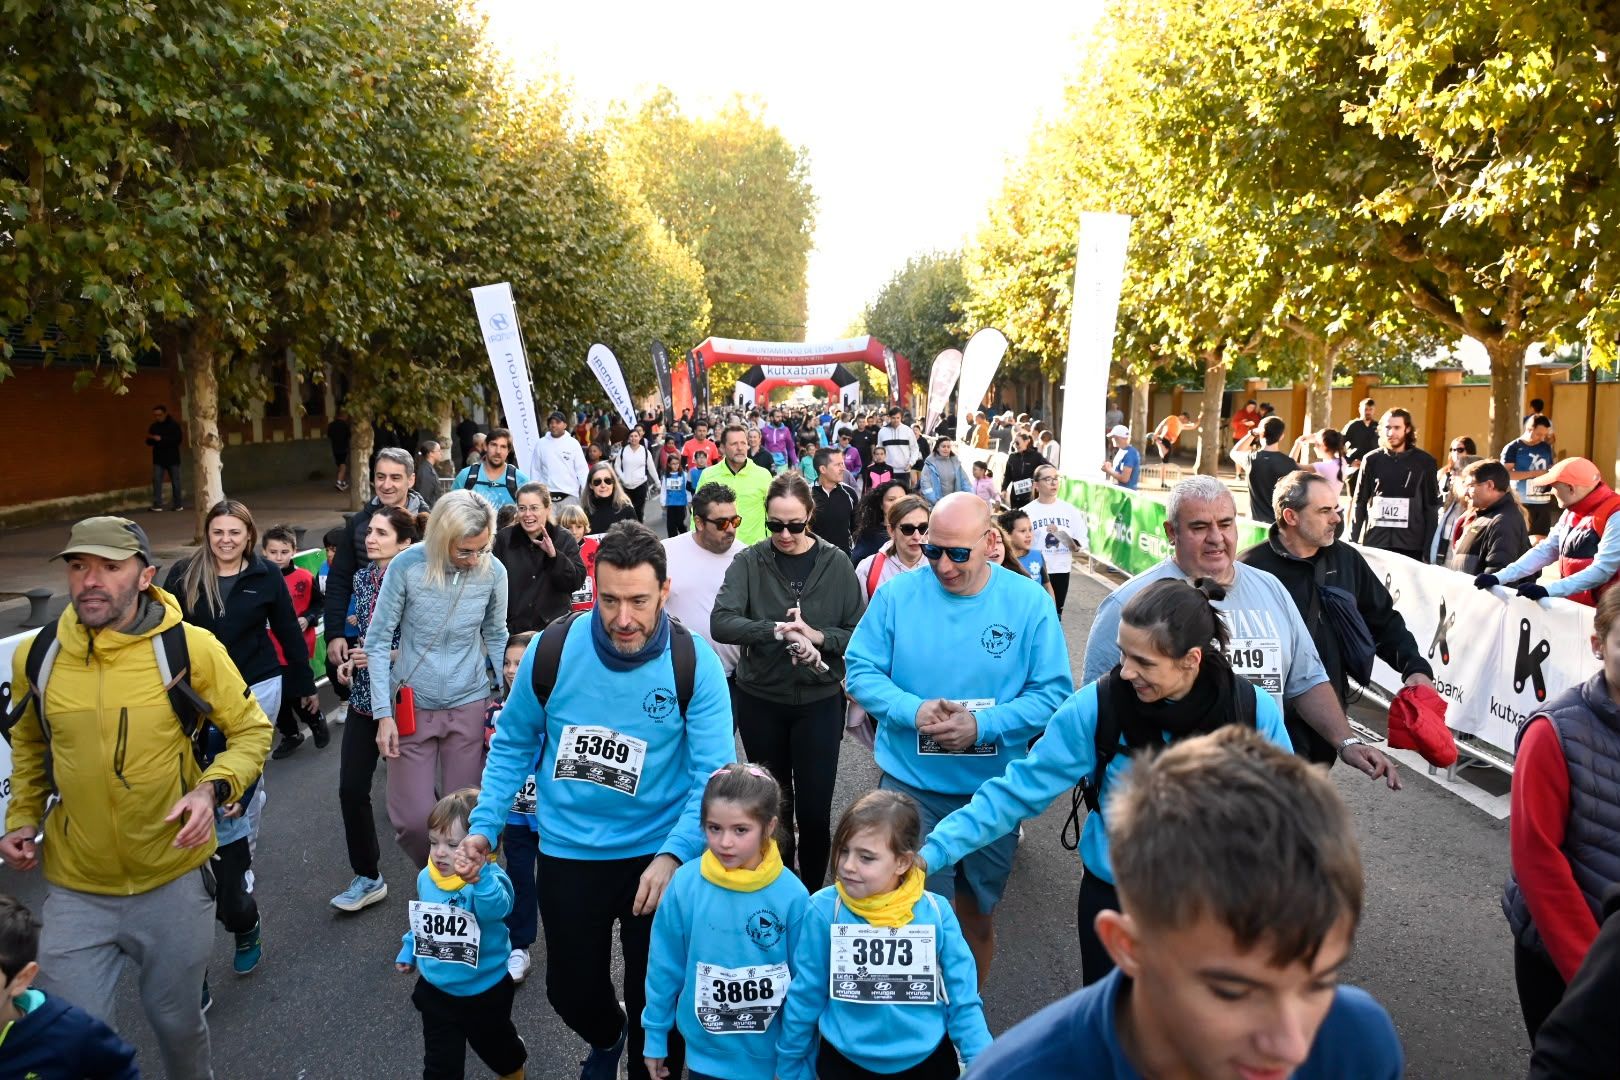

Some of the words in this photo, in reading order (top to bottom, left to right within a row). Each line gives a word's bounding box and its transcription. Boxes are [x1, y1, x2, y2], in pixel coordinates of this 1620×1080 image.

[767, 365, 830, 376] kutxabank
[1033, 517, 1070, 530] BROWNIE
[1382, 506, 1399, 517] 1412
[1490, 696, 1528, 727] kutxa
[574, 735, 630, 764] 5369
[422, 913, 468, 936] 3842
[852, 938, 913, 966] 3873
[712, 977, 774, 1003] 3868
